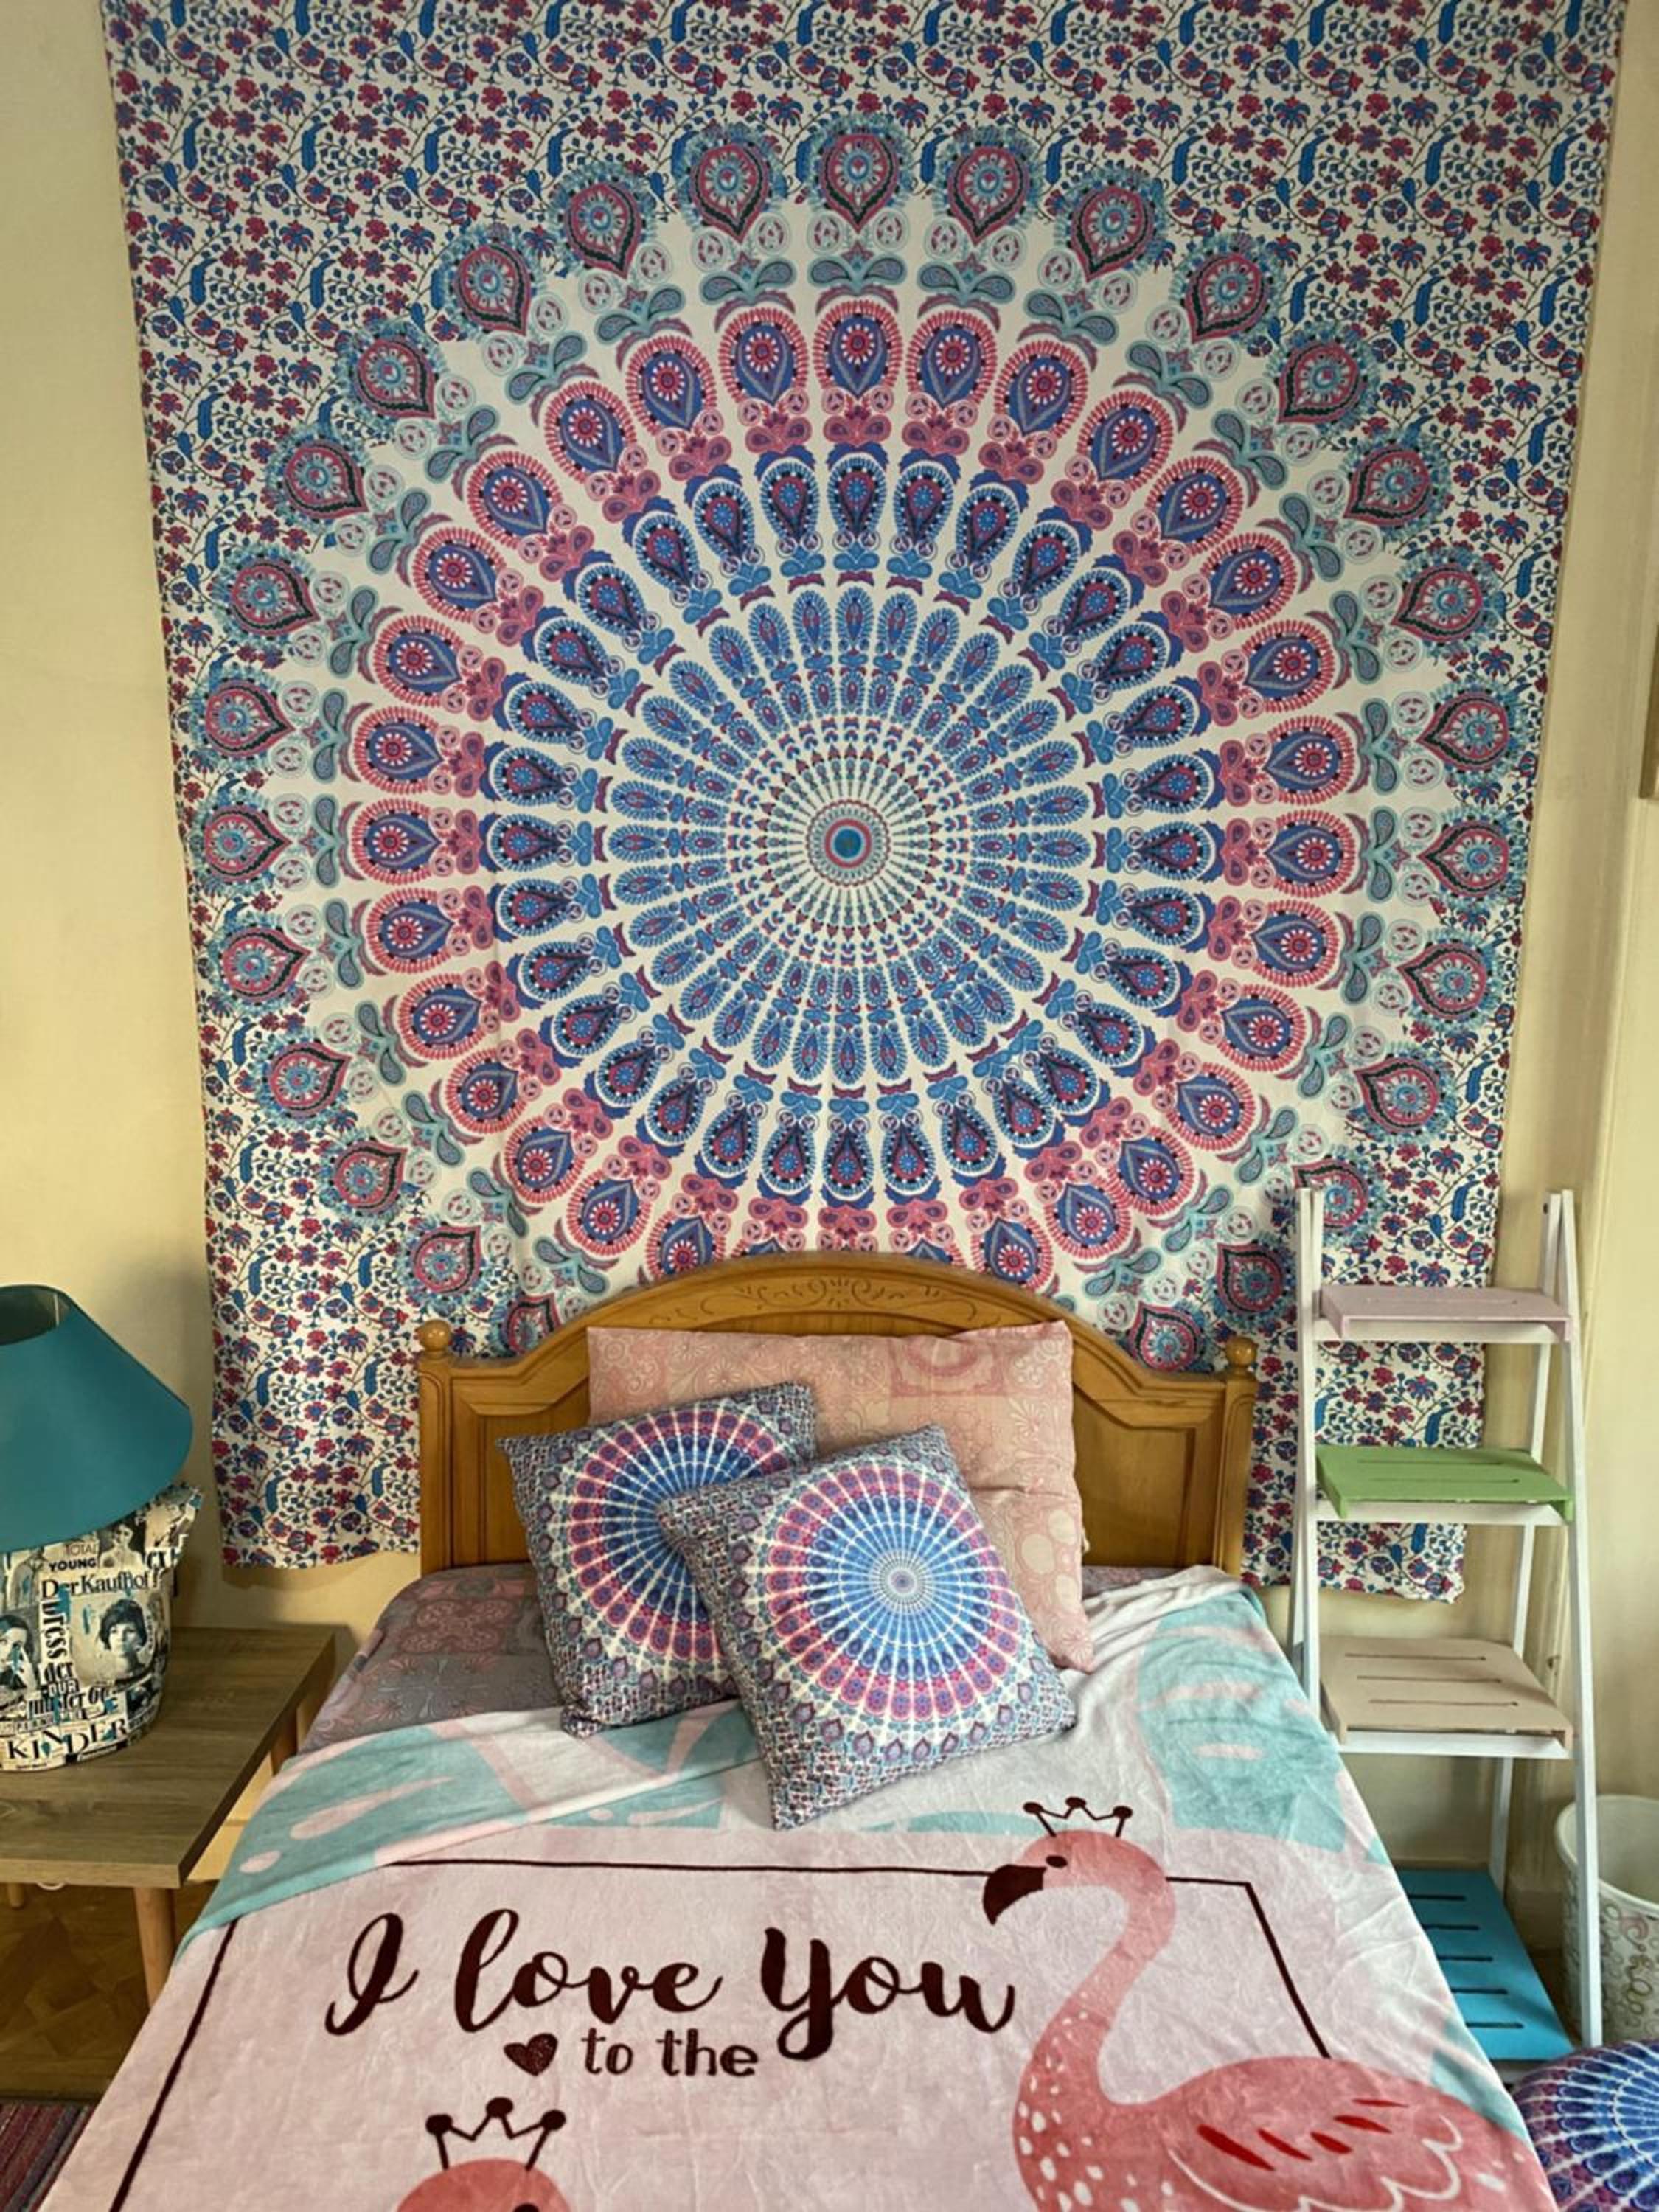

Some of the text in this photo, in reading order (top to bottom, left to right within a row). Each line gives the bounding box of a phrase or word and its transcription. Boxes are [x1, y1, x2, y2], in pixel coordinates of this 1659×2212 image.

[49, 1557, 97, 1571] YOUNG
[325, 1913, 419, 2036] I
[455, 1909, 723, 2033] love
[582, 2028, 758, 2077] to the
